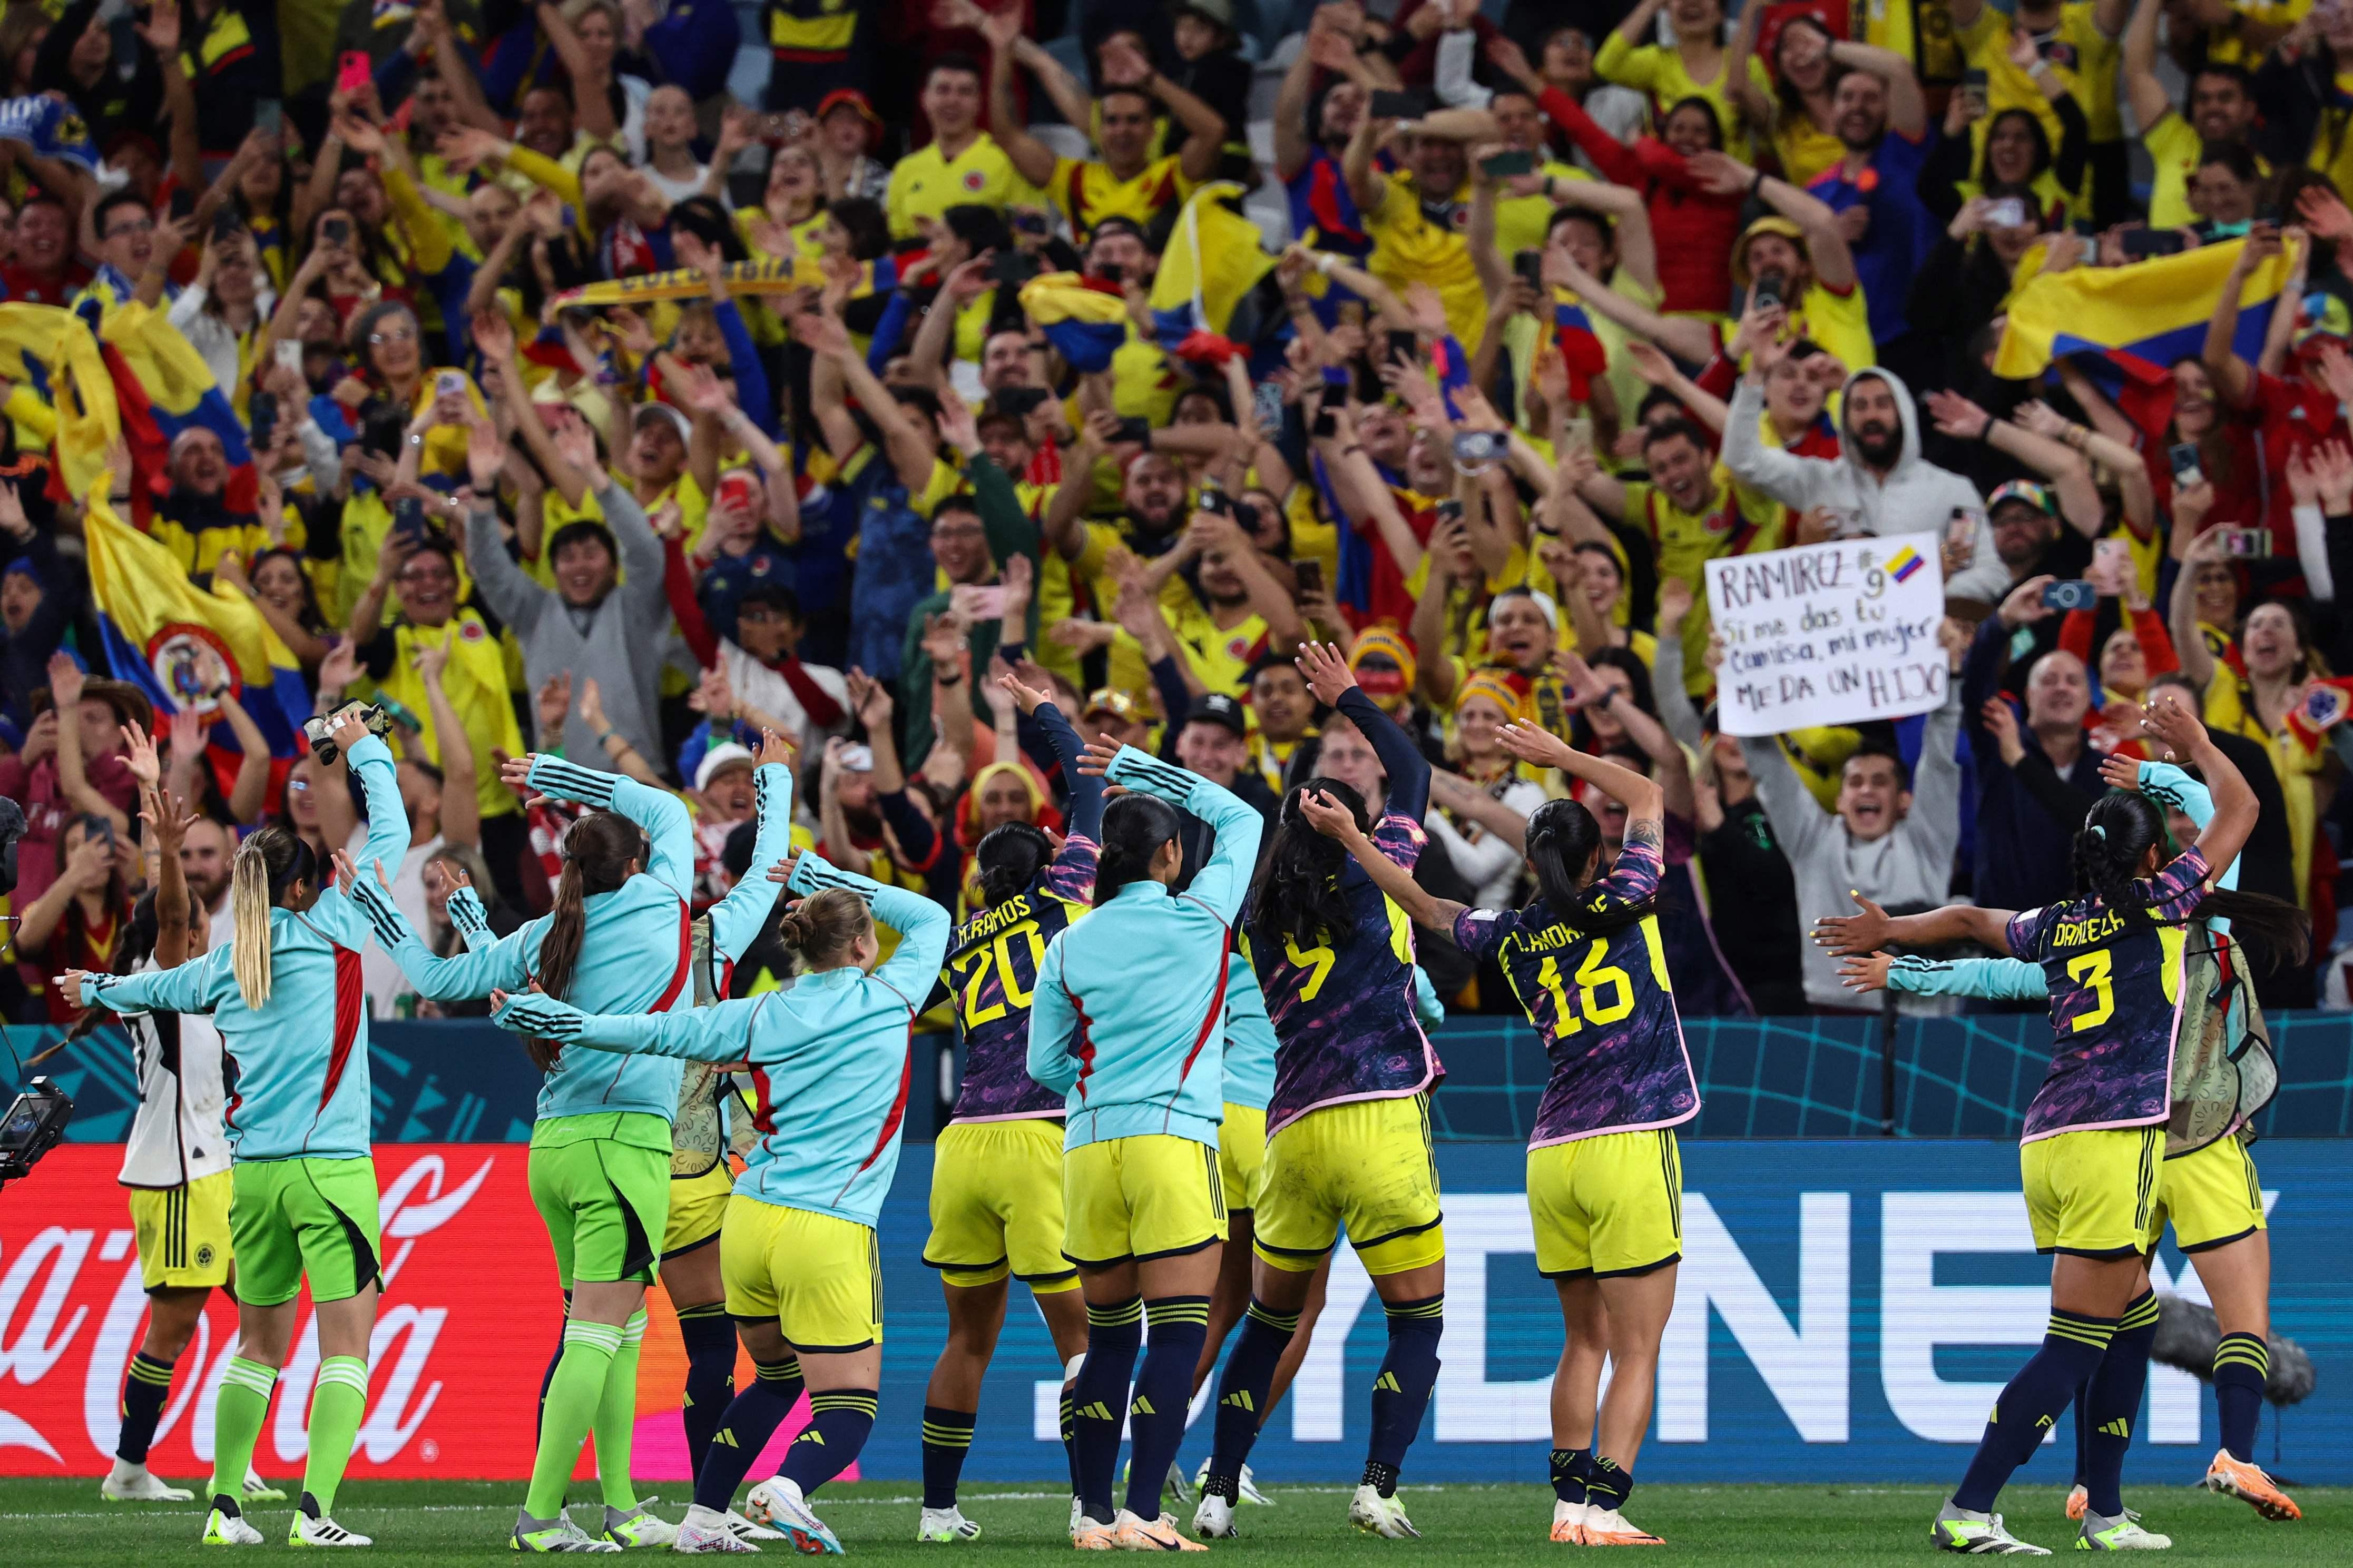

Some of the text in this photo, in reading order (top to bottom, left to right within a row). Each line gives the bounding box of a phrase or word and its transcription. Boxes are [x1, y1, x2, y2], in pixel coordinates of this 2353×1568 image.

[1720, 549, 1850, 608] RAMIREZ
[1754, 619, 1786, 639] me
[1800, 603, 1842, 632] das
[1856, 599, 1885, 623] tu
[1829, 628, 1857, 655] mi
[1865, 616, 1933, 657] mujer
[1827, 664, 1860, 694] UN
[1866, 663, 1947, 708] HIJO
[958, 894, 1031, 949] M.RAMOS
[2053, 908, 2125, 946] DANIELA
[951, 919, 1046, 1030] 20
[1537, 936, 1635, 1039] 16
[2067, 949, 2115, 1033] 3
